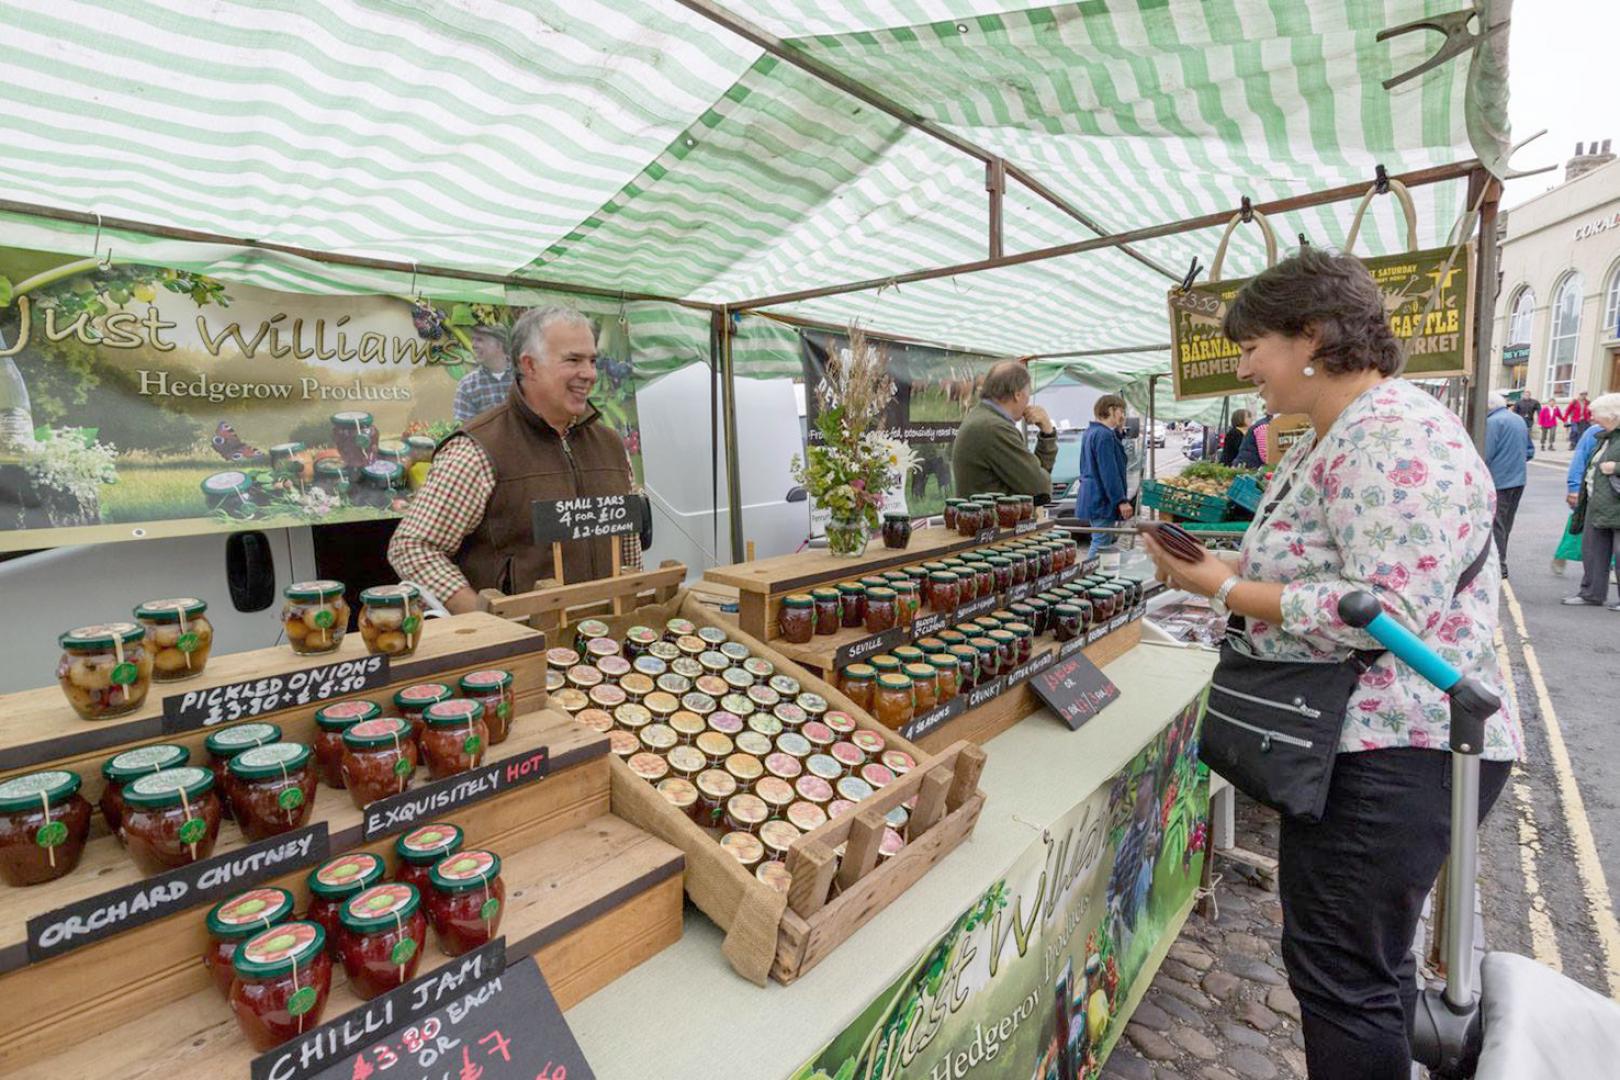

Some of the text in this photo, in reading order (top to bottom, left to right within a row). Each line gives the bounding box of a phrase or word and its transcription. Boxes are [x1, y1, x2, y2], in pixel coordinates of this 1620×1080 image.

[1573, 212, 1617, 242] CORAL
[1378, 264, 1417, 277] SATURDAY
[0, 295, 472, 366] Just Williams
[1409, 334, 1460, 355] RKET
[1181, 336, 1242, 362] BARNAR
[1183, 358, 1239, 379] FARMER
[136, 369, 411, 402] Hedgerow Products
[556, 496, 624, 513] SMALL JARS
[560, 508, 626, 527] 4 FOR £10
[611, 522, 633, 532] EACH
[848, 637, 883, 657] SEVILLE
[180, 656, 381, 714] PICKLED ONIONS
[970, 681, 1001, 705] CHUNKY
[915, 705, 950, 733] SEASONS
[366, 754, 544, 834] EXQUISITELY HOT
[39, 833, 314, 948] ORCHARD CHUTNEY
[446, 976, 502, 1025] EACH
[268, 954, 482, 1080] CHILLI JAM
[418, 1036, 461, 1068] OR
